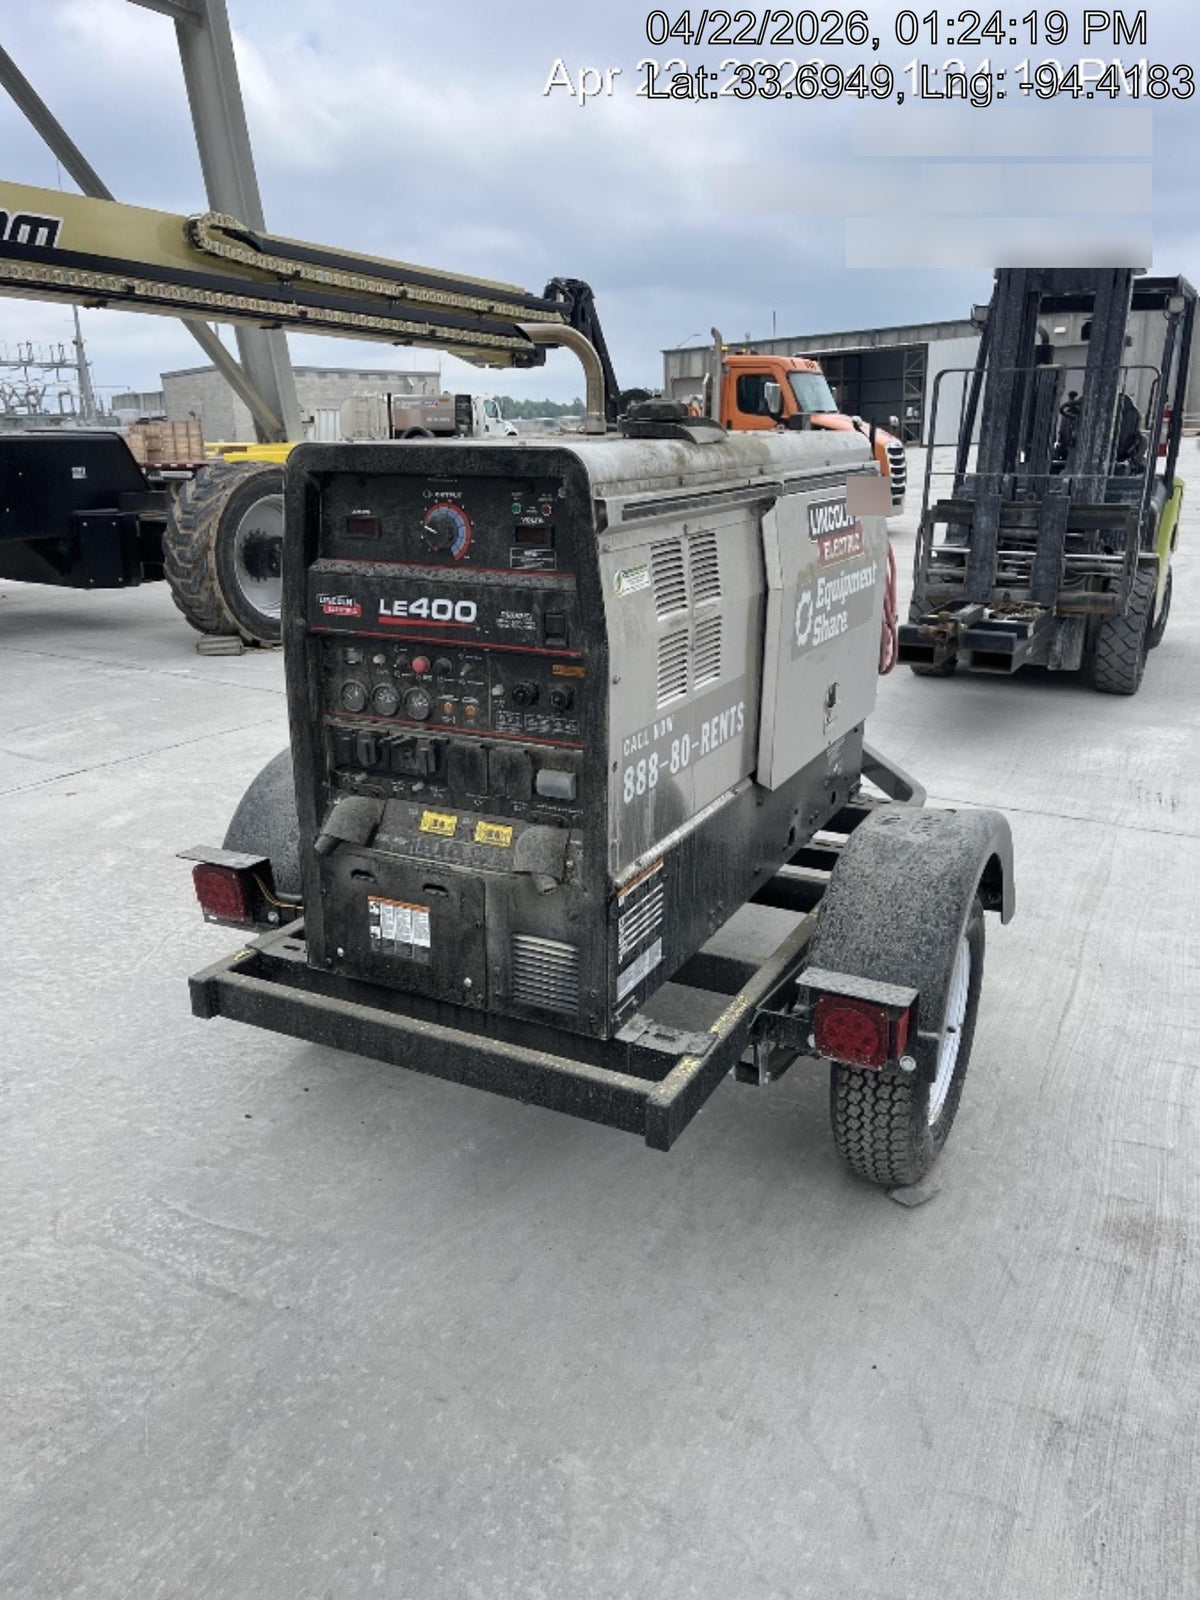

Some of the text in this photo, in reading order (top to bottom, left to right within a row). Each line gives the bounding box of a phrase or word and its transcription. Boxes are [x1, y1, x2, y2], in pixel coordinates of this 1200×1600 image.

[816, 560, 878, 611] Equipment
[378, 597, 478, 623] LE400
[812, 610, 849, 647] Share
[623, 700, 745, 805] 888-80-RENTS
